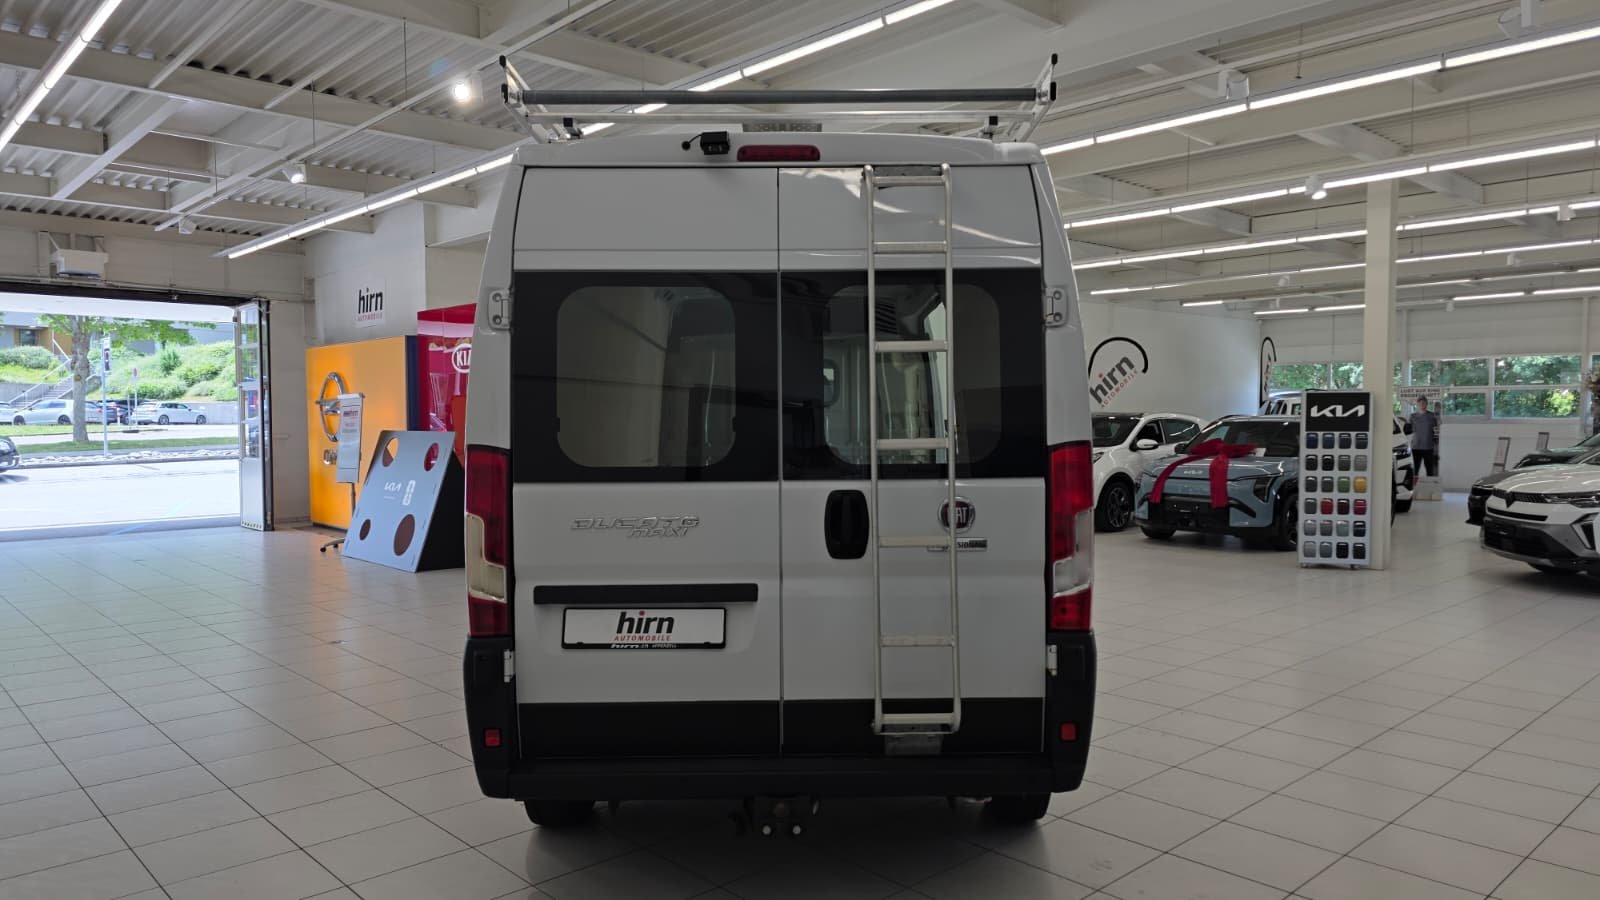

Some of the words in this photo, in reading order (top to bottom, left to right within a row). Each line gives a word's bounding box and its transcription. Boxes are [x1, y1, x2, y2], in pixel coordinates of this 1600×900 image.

[358, 287, 383, 314] hirn
[1089, 356, 1135, 404] hirn
[1310, 404, 1366, 418] KIA
[571, 516, 700, 529] DUCATO
[627, 527, 689, 538] MAXI
[616, 610, 675, 634] hirn
[614, 634, 672, 642] AUTOMOBILE
